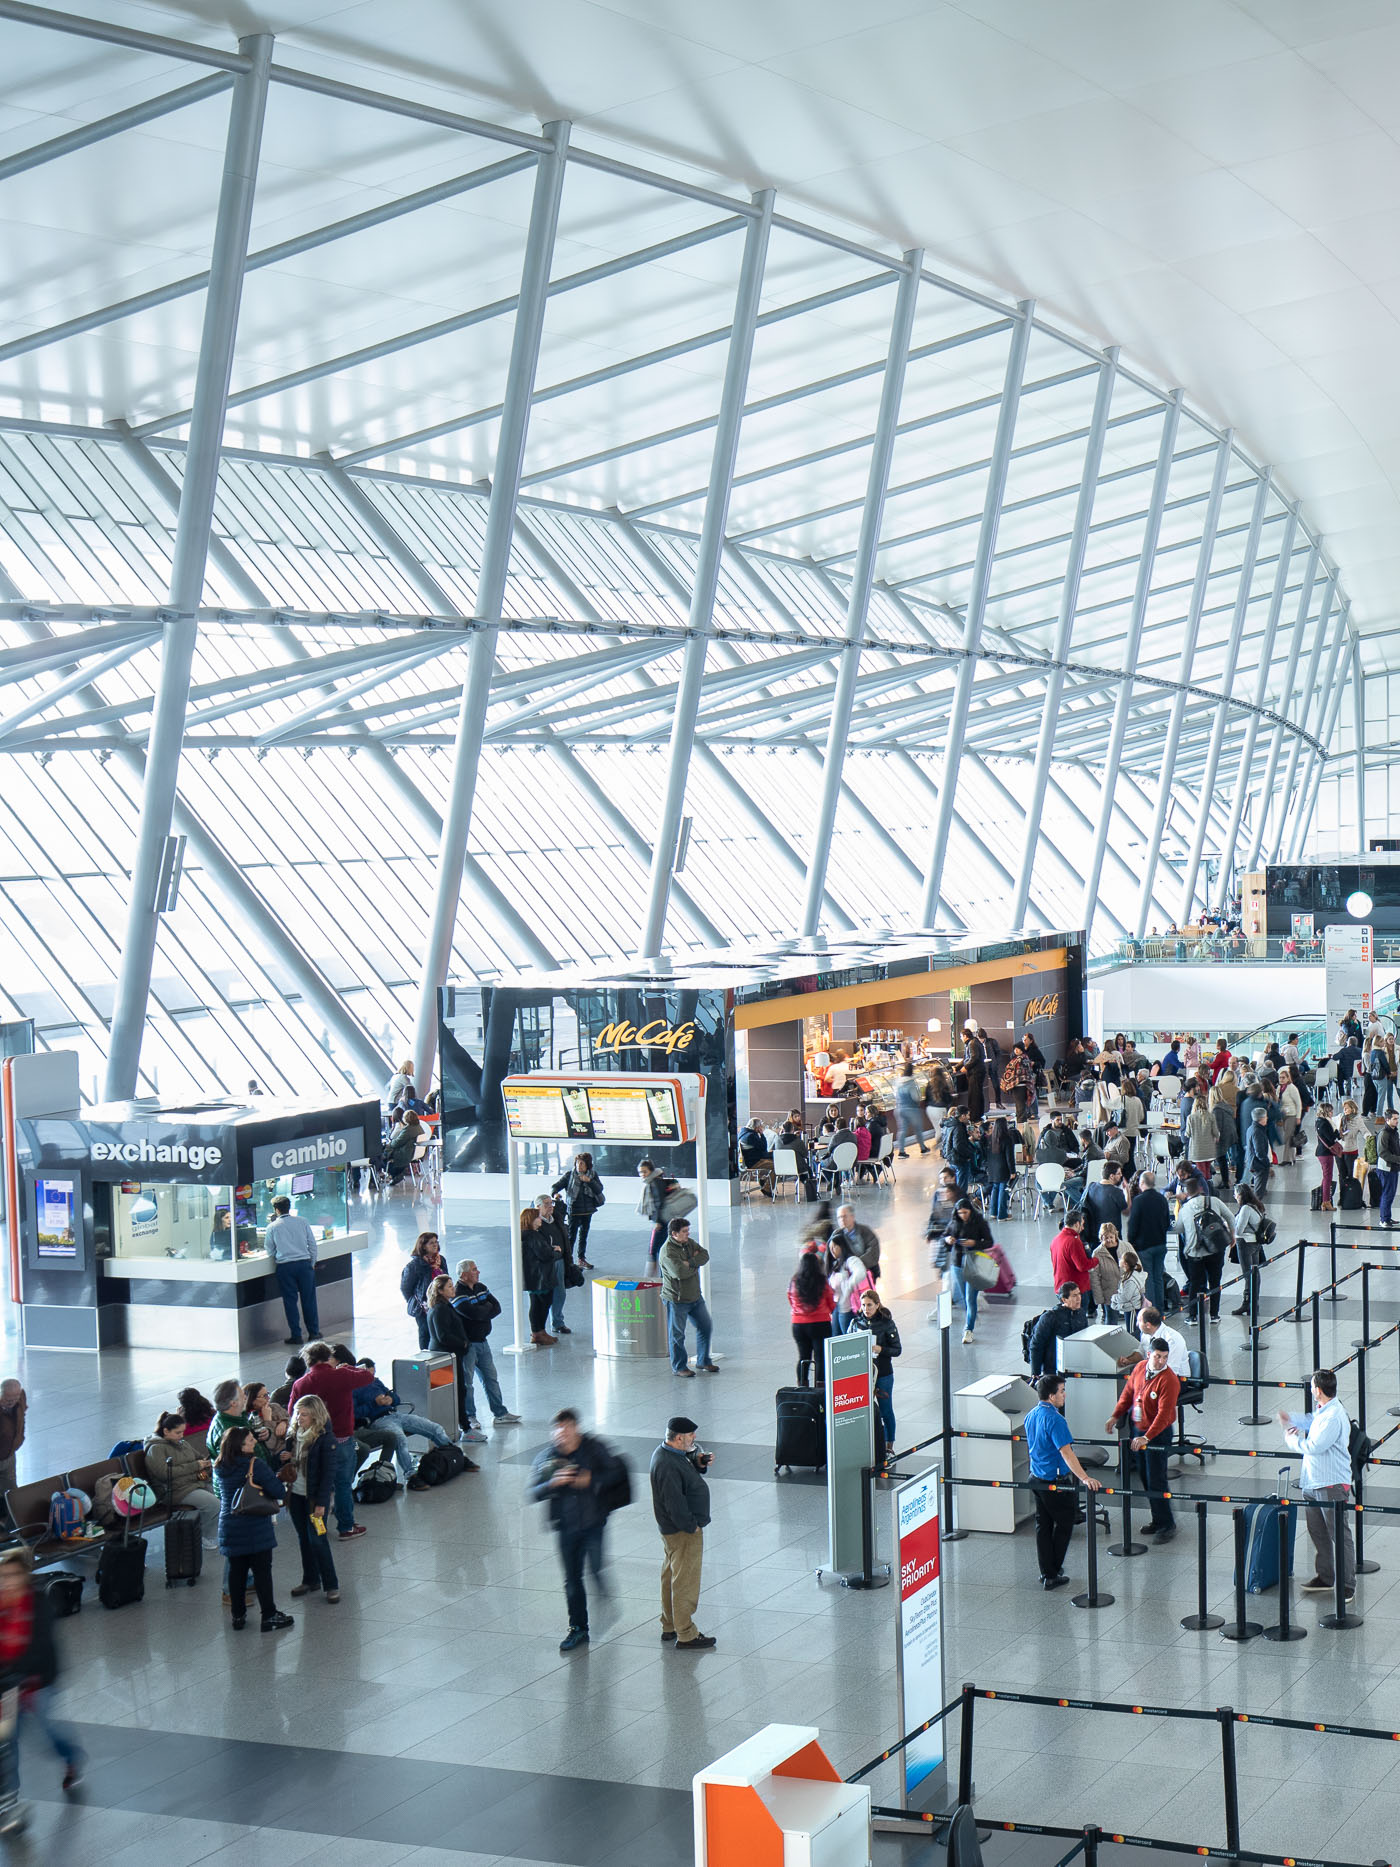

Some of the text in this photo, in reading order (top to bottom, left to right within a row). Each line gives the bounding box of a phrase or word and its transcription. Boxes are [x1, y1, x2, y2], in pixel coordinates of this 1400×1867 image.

[1024, 993, 1059, 1024] McCafé
[594, 1019, 695, 1054] McCafé
[92, 1139, 222, 1170] exchange
[271, 1135, 347, 1169] cambio
[131, 1221, 158, 1232] global
[834, 1393, 848, 1402] SKY
[834, 1395, 864, 1408] PRIORITY
[901, 1558, 917, 1577] SKY
[901, 1558, 936, 1590] PRIORITY
